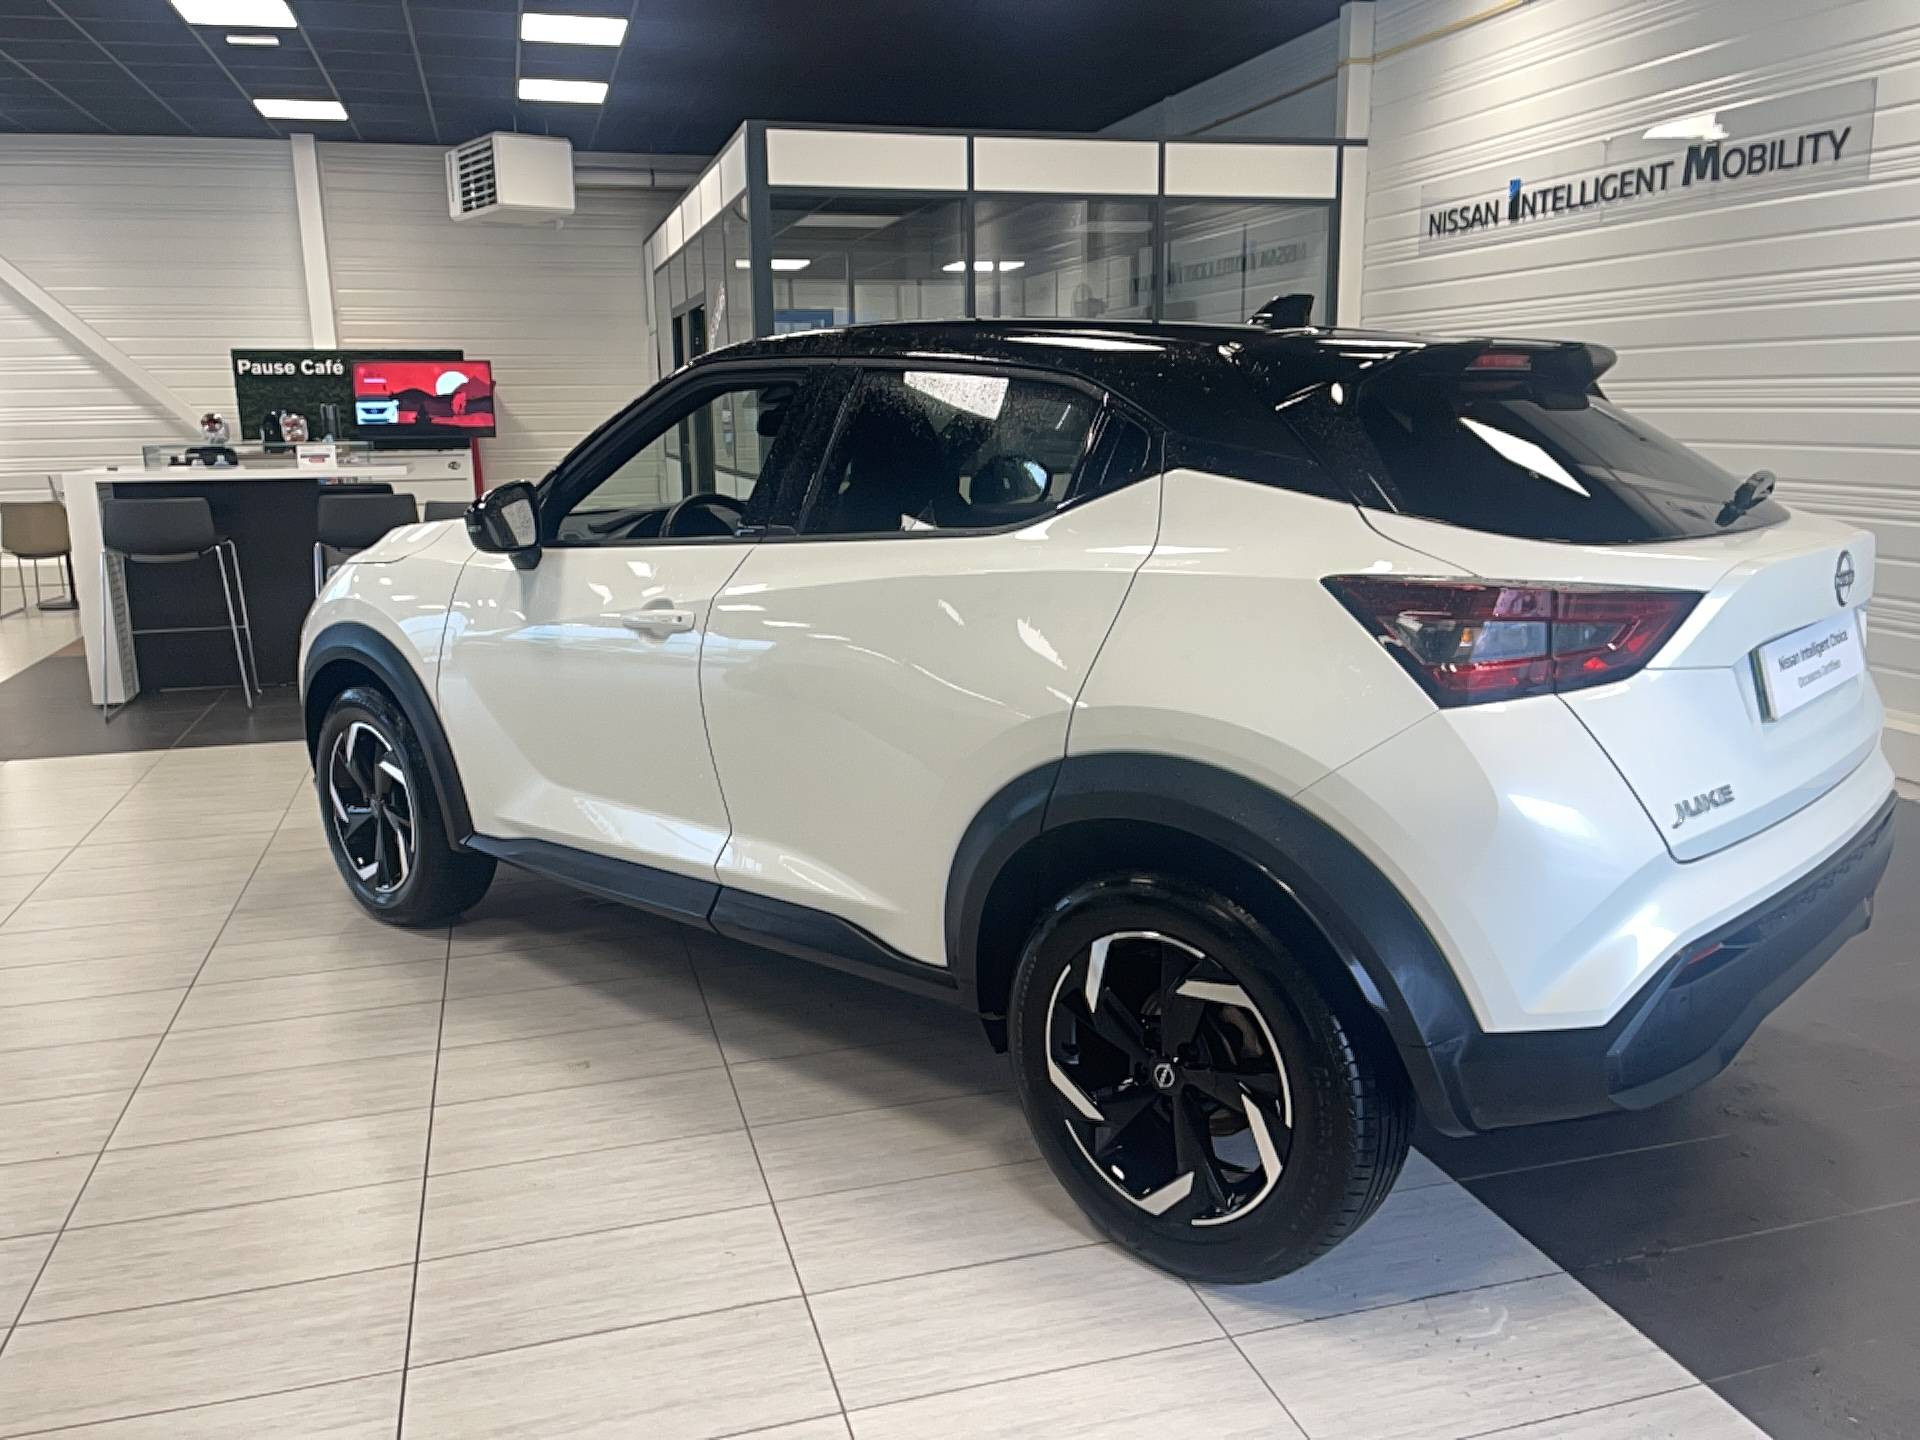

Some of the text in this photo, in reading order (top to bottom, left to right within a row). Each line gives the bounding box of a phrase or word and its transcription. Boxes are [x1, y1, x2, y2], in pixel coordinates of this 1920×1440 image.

[1429, 126, 1851, 237] NISSAN INTELLIGENT MOBILITY
[237, 358, 344, 375] Pause Café
[1778, 653, 1799, 672] Nissan
[1672, 783, 1735, 829] JUKE
